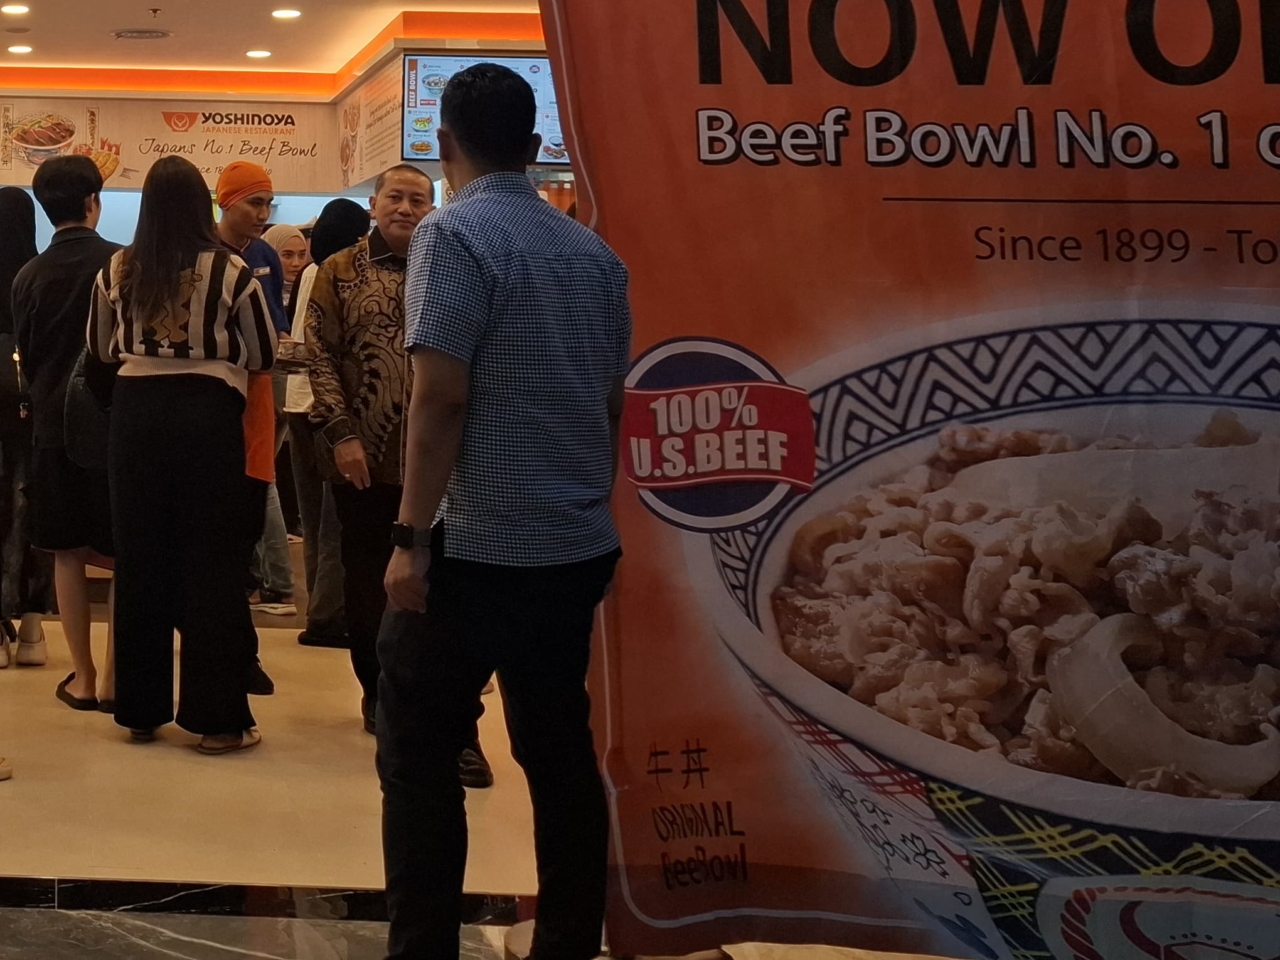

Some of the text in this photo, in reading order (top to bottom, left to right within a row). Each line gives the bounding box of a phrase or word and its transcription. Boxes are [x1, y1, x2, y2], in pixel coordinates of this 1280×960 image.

[201, 112, 296, 126] YOSHINOYA
[201, 126, 295, 135] JAPANESE RESTAURANT
[696, 107, 847, 164] Beef
[865, 108, 1032, 165] Bowl
[1055, 110, 1177, 168] No.
[1197, 109, 1228, 168] 1
[239, 138, 276, 163] Beef
[278, 141, 318, 157] Bowl
[974, 227, 1083, 264] Since
[1095, 228, 1190, 263] 1899
[649, 387, 758, 436] 100%
[630, 430, 788, 478] U.S.BEEF
